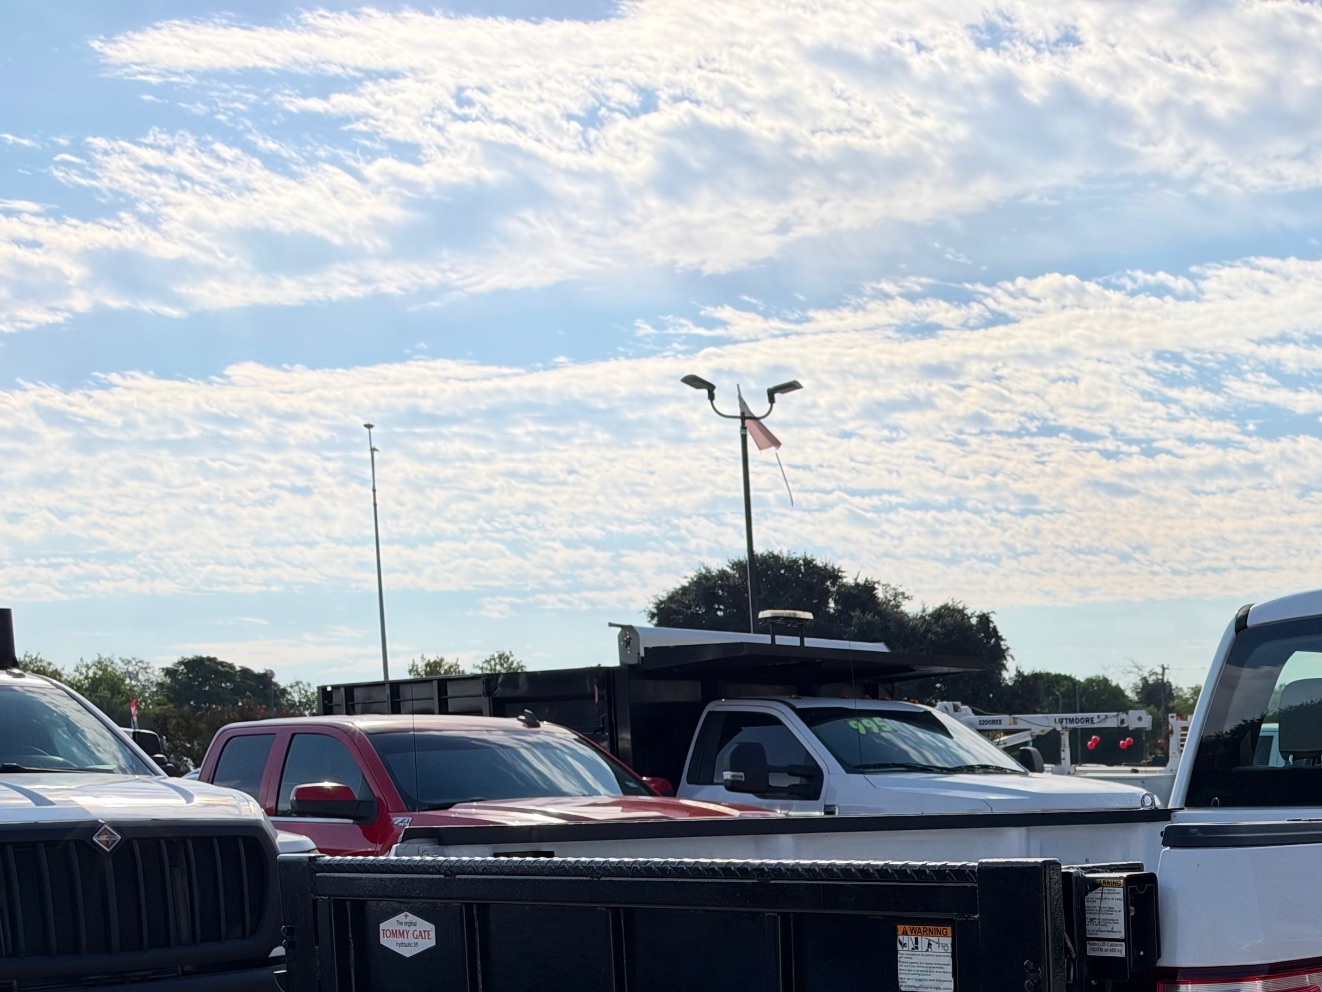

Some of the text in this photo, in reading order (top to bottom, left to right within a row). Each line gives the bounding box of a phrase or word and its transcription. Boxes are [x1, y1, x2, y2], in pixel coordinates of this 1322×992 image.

[1054, 717, 1095, 725] LIFTMOORE
[1096, 879, 1122, 887] RNING
[381, 928, 432, 940] TOMMY GATE
[909, 926, 948, 936] WARNING
